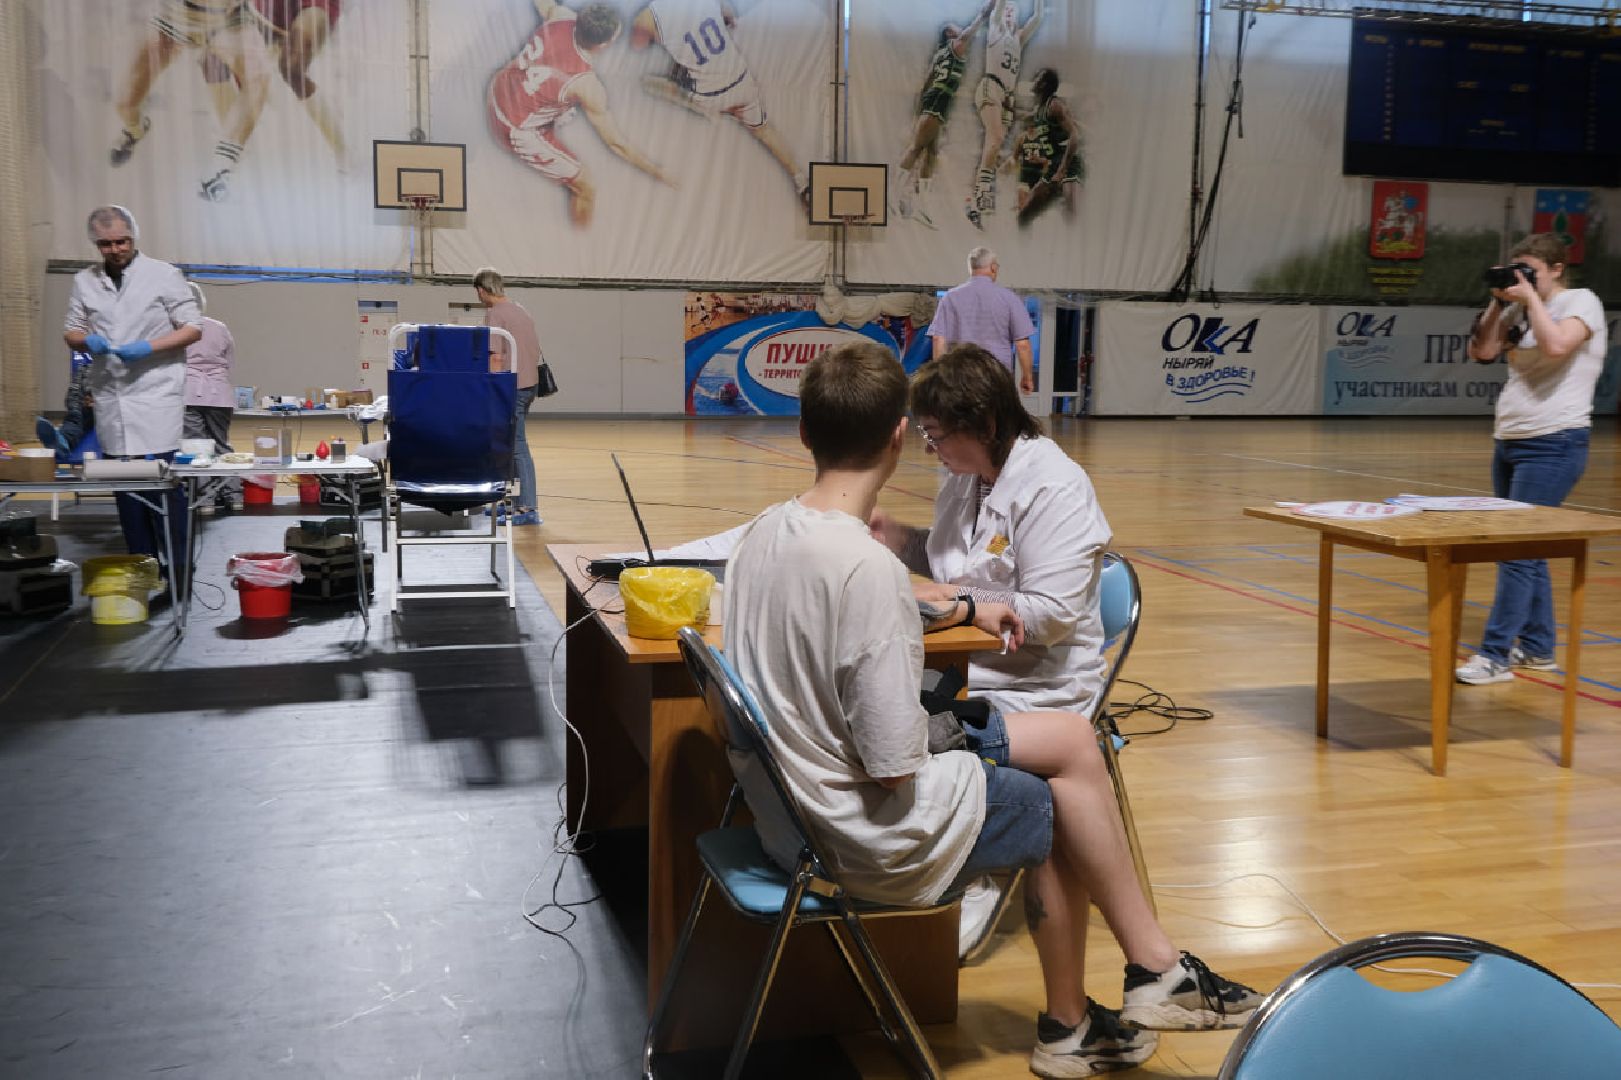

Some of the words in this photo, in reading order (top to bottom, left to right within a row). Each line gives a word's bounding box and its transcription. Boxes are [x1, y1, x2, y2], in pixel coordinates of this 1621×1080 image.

[683, 17, 726, 65] 10
[518, 35, 551, 96] 24
[1163, 355, 1214, 369] НЫРЯЙ
[1166, 373, 1174, 386] В
[1333, 381, 1458, 406] участникам
[1465, 381, 1505, 406] сор
